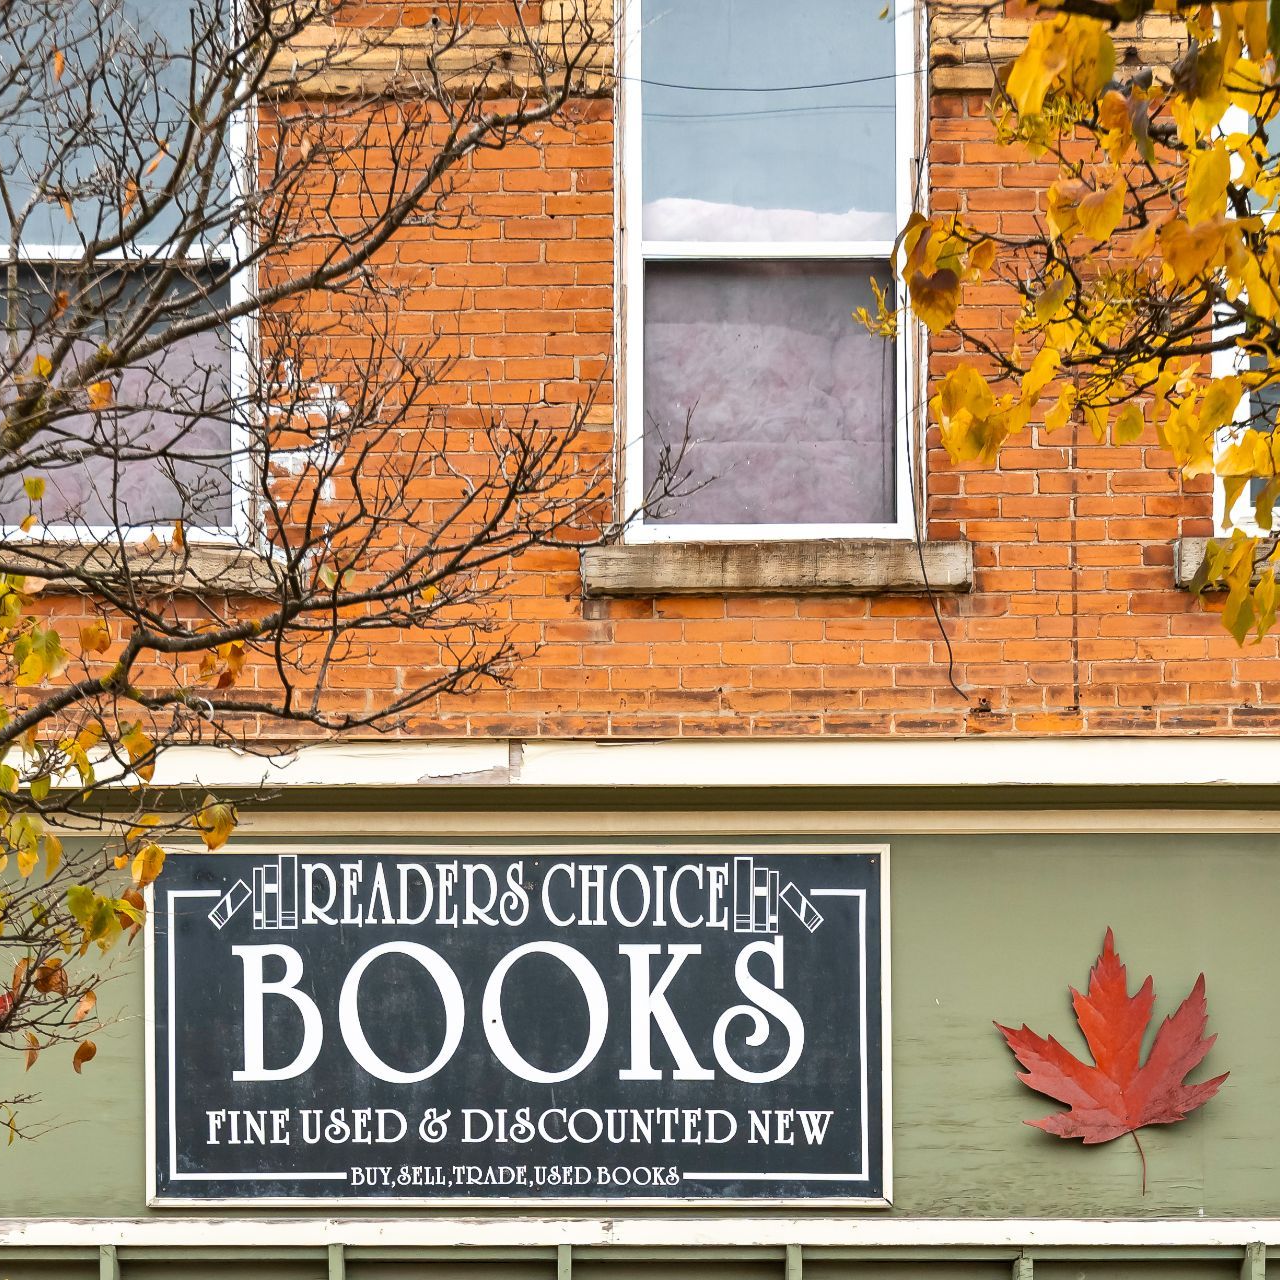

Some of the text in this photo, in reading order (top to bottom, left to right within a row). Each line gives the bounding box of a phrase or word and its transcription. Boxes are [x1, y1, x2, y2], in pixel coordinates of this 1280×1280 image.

[301, 860, 729, 931] READERS CHOICE
[231, 936, 805, 1084] BOOKS
[206, 1107, 834, 1146] FINE USED & DISCOUNTED NEW
[597, 1165, 680, 1185] BOOKS
